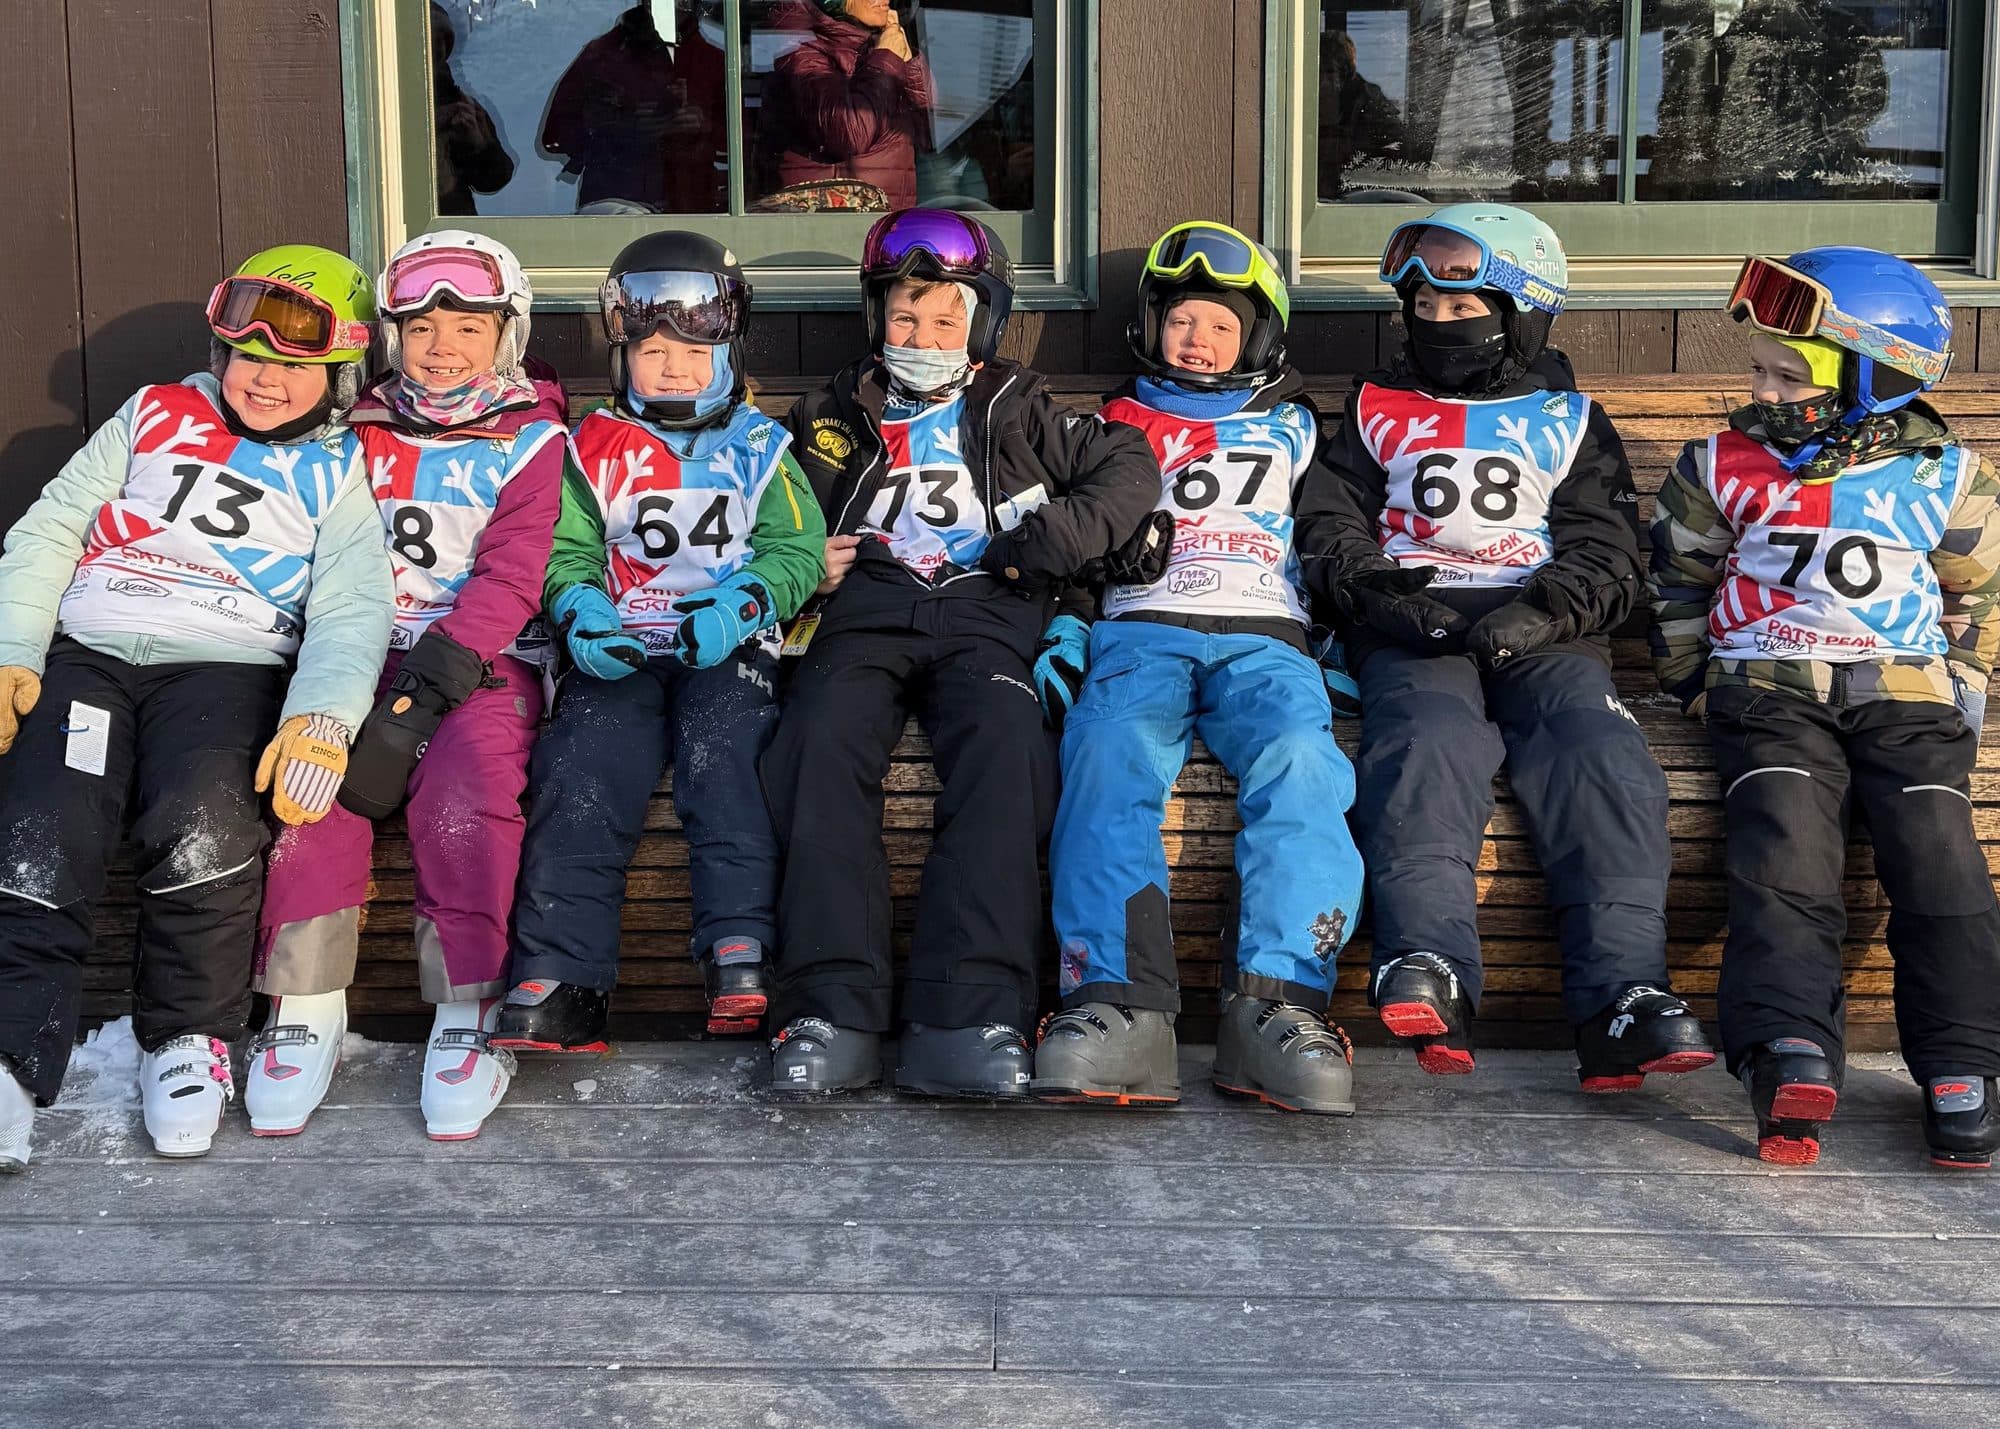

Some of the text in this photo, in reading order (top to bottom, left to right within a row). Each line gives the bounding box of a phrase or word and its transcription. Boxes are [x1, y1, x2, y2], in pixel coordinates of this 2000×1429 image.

[1525, 261, 1560, 276] SMITH
[1172, 452, 1273, 510] 67
[1412, 453, 1521, 521] 68
[160, 463, 265, 539] 13
[392, 506, 438, 569] 8
[632, 495, 734, 559] 64
[1475, 531, 1525, 558] PEAK
[1176, 569, 1209, 579] TMS
[1767, 531, 1882, 599] 70
[1171, 573, 1216, 595] Diesel
[627, 597, 669, 614] SKI
[1767, 619, 1878, 648] PATS PEAK
[310, 745, 337, 760] KINCO
